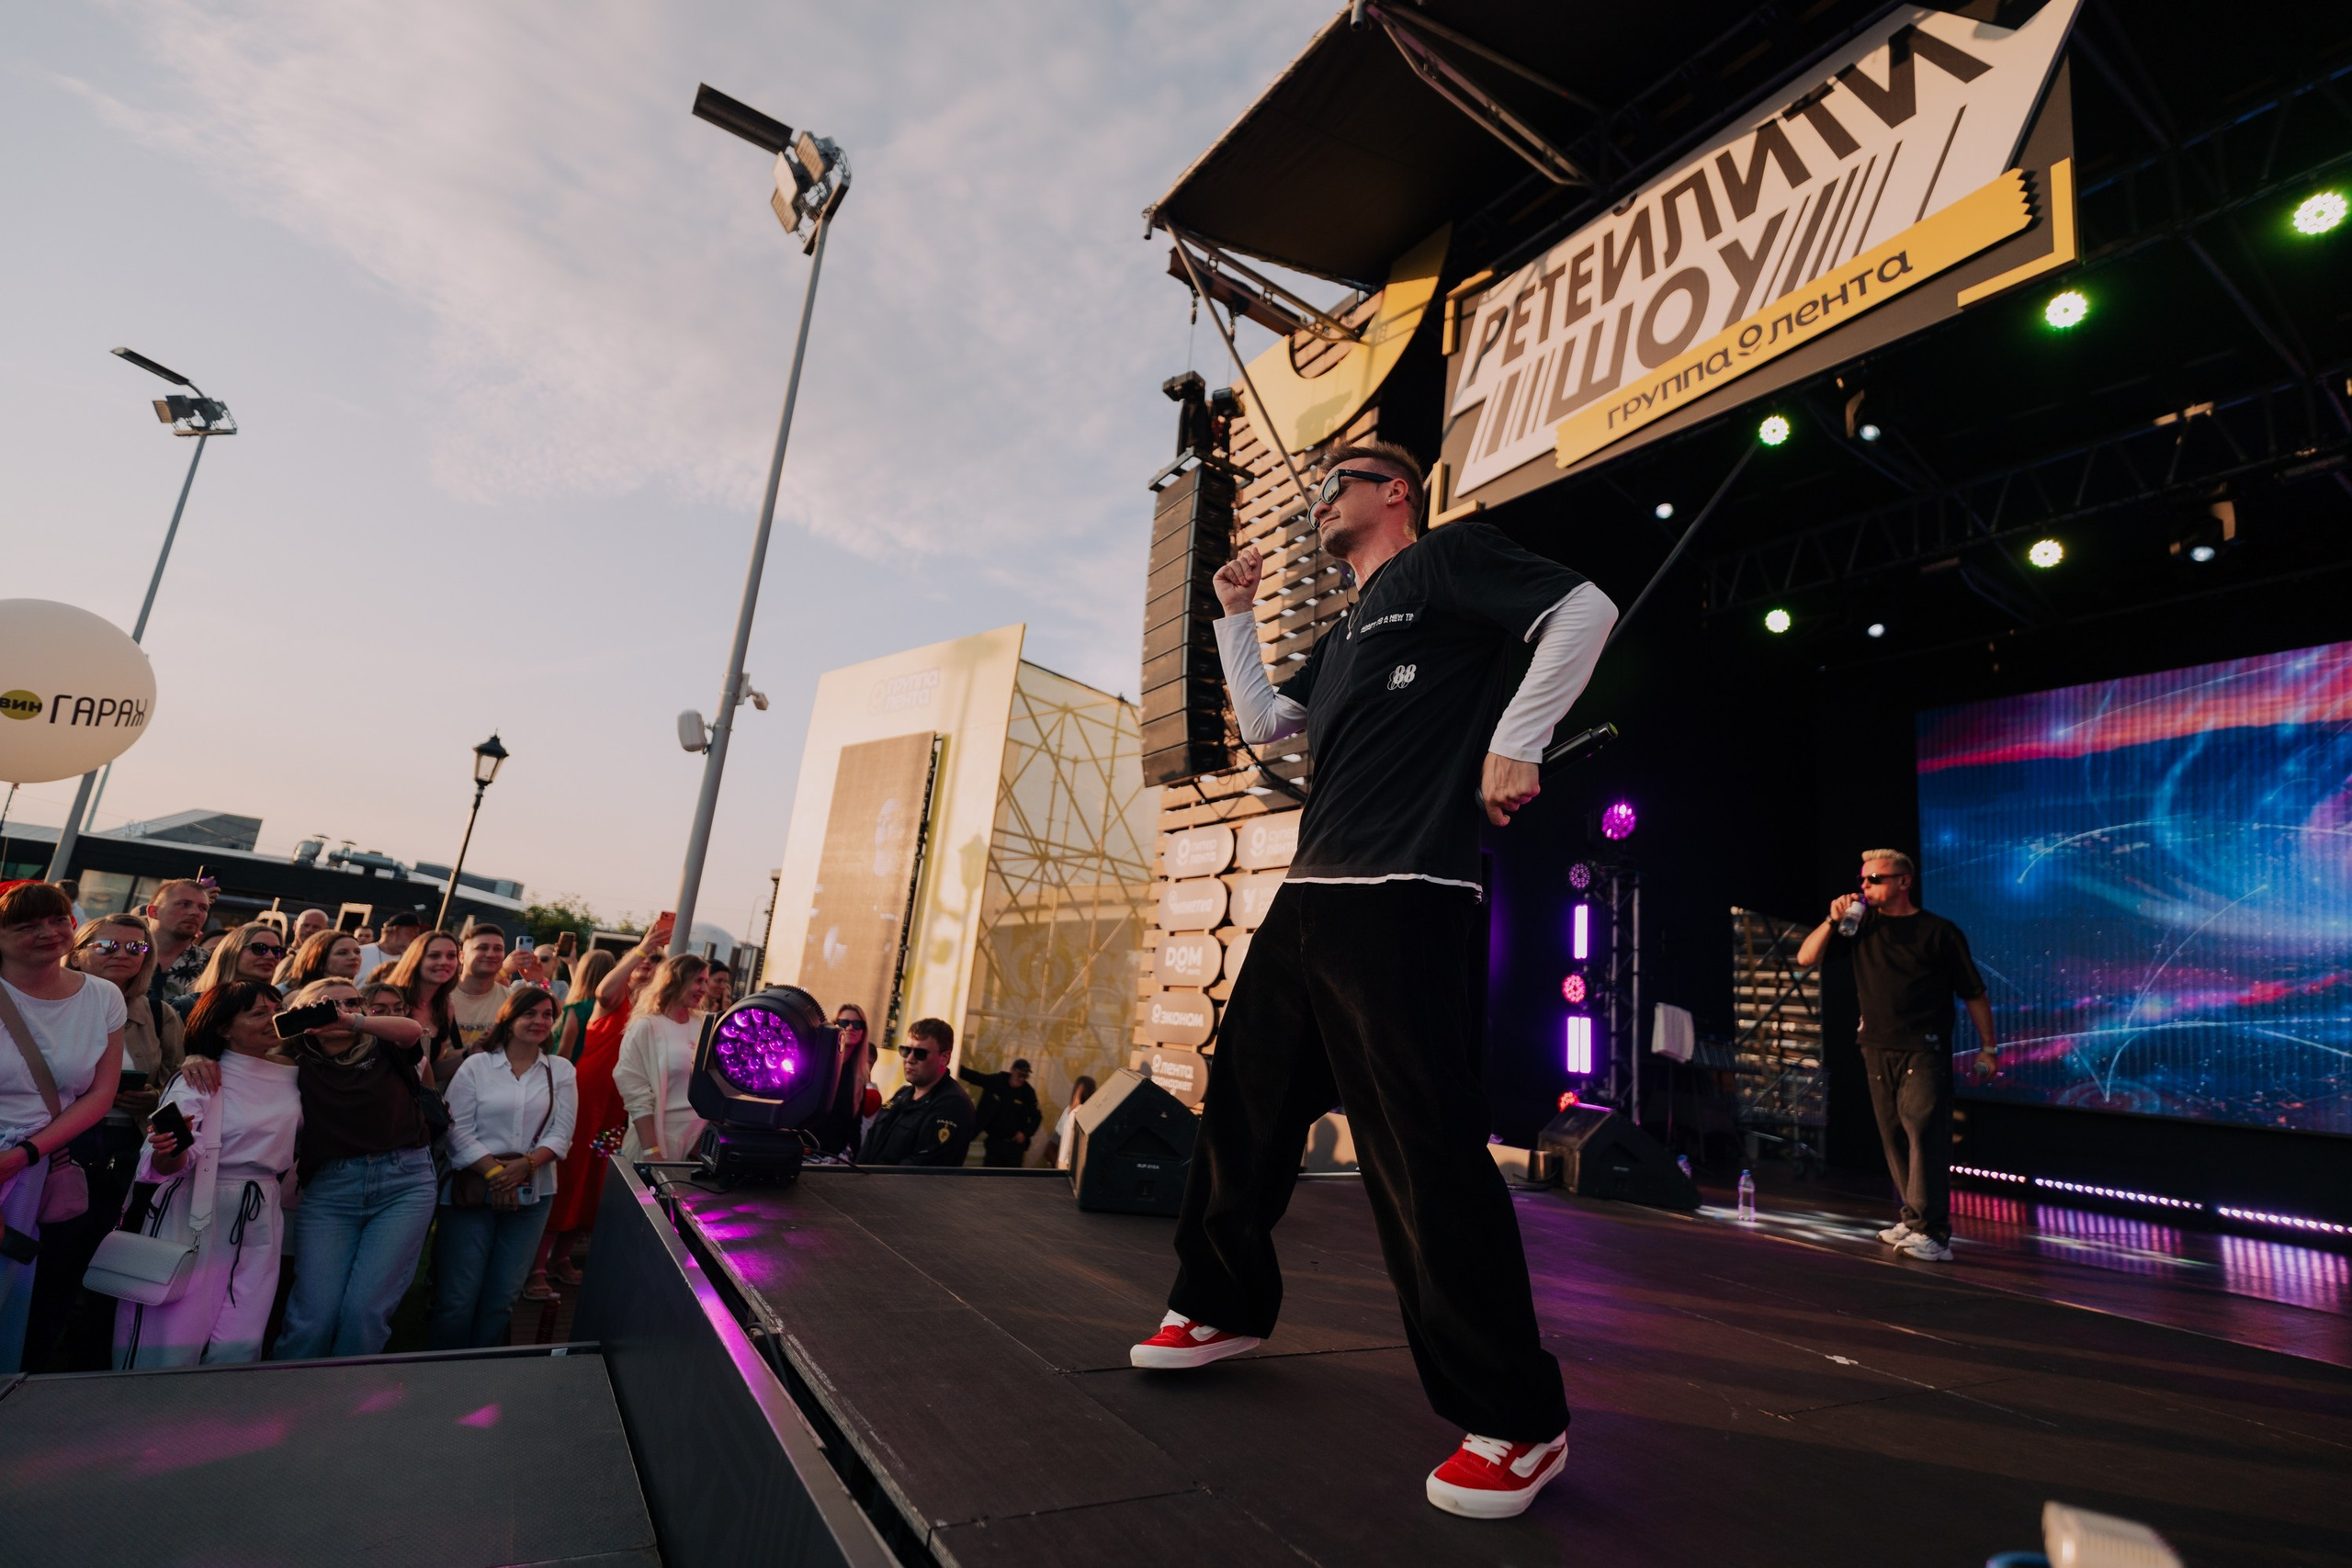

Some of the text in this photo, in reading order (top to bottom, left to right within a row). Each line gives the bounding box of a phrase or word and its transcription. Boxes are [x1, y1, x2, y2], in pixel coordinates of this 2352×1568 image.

[1465, 23, 1994, 389] РЕТЕЙЛИТИ
[1544, 207, 1790, 428] ШОУ
[1608, 250, 1913, 429] группа лента
[1389, 614, 1404, 623] NEW
[49, 694, 148, 727] ГАРАЖ
[1387, 664, 1417, 690] 88
